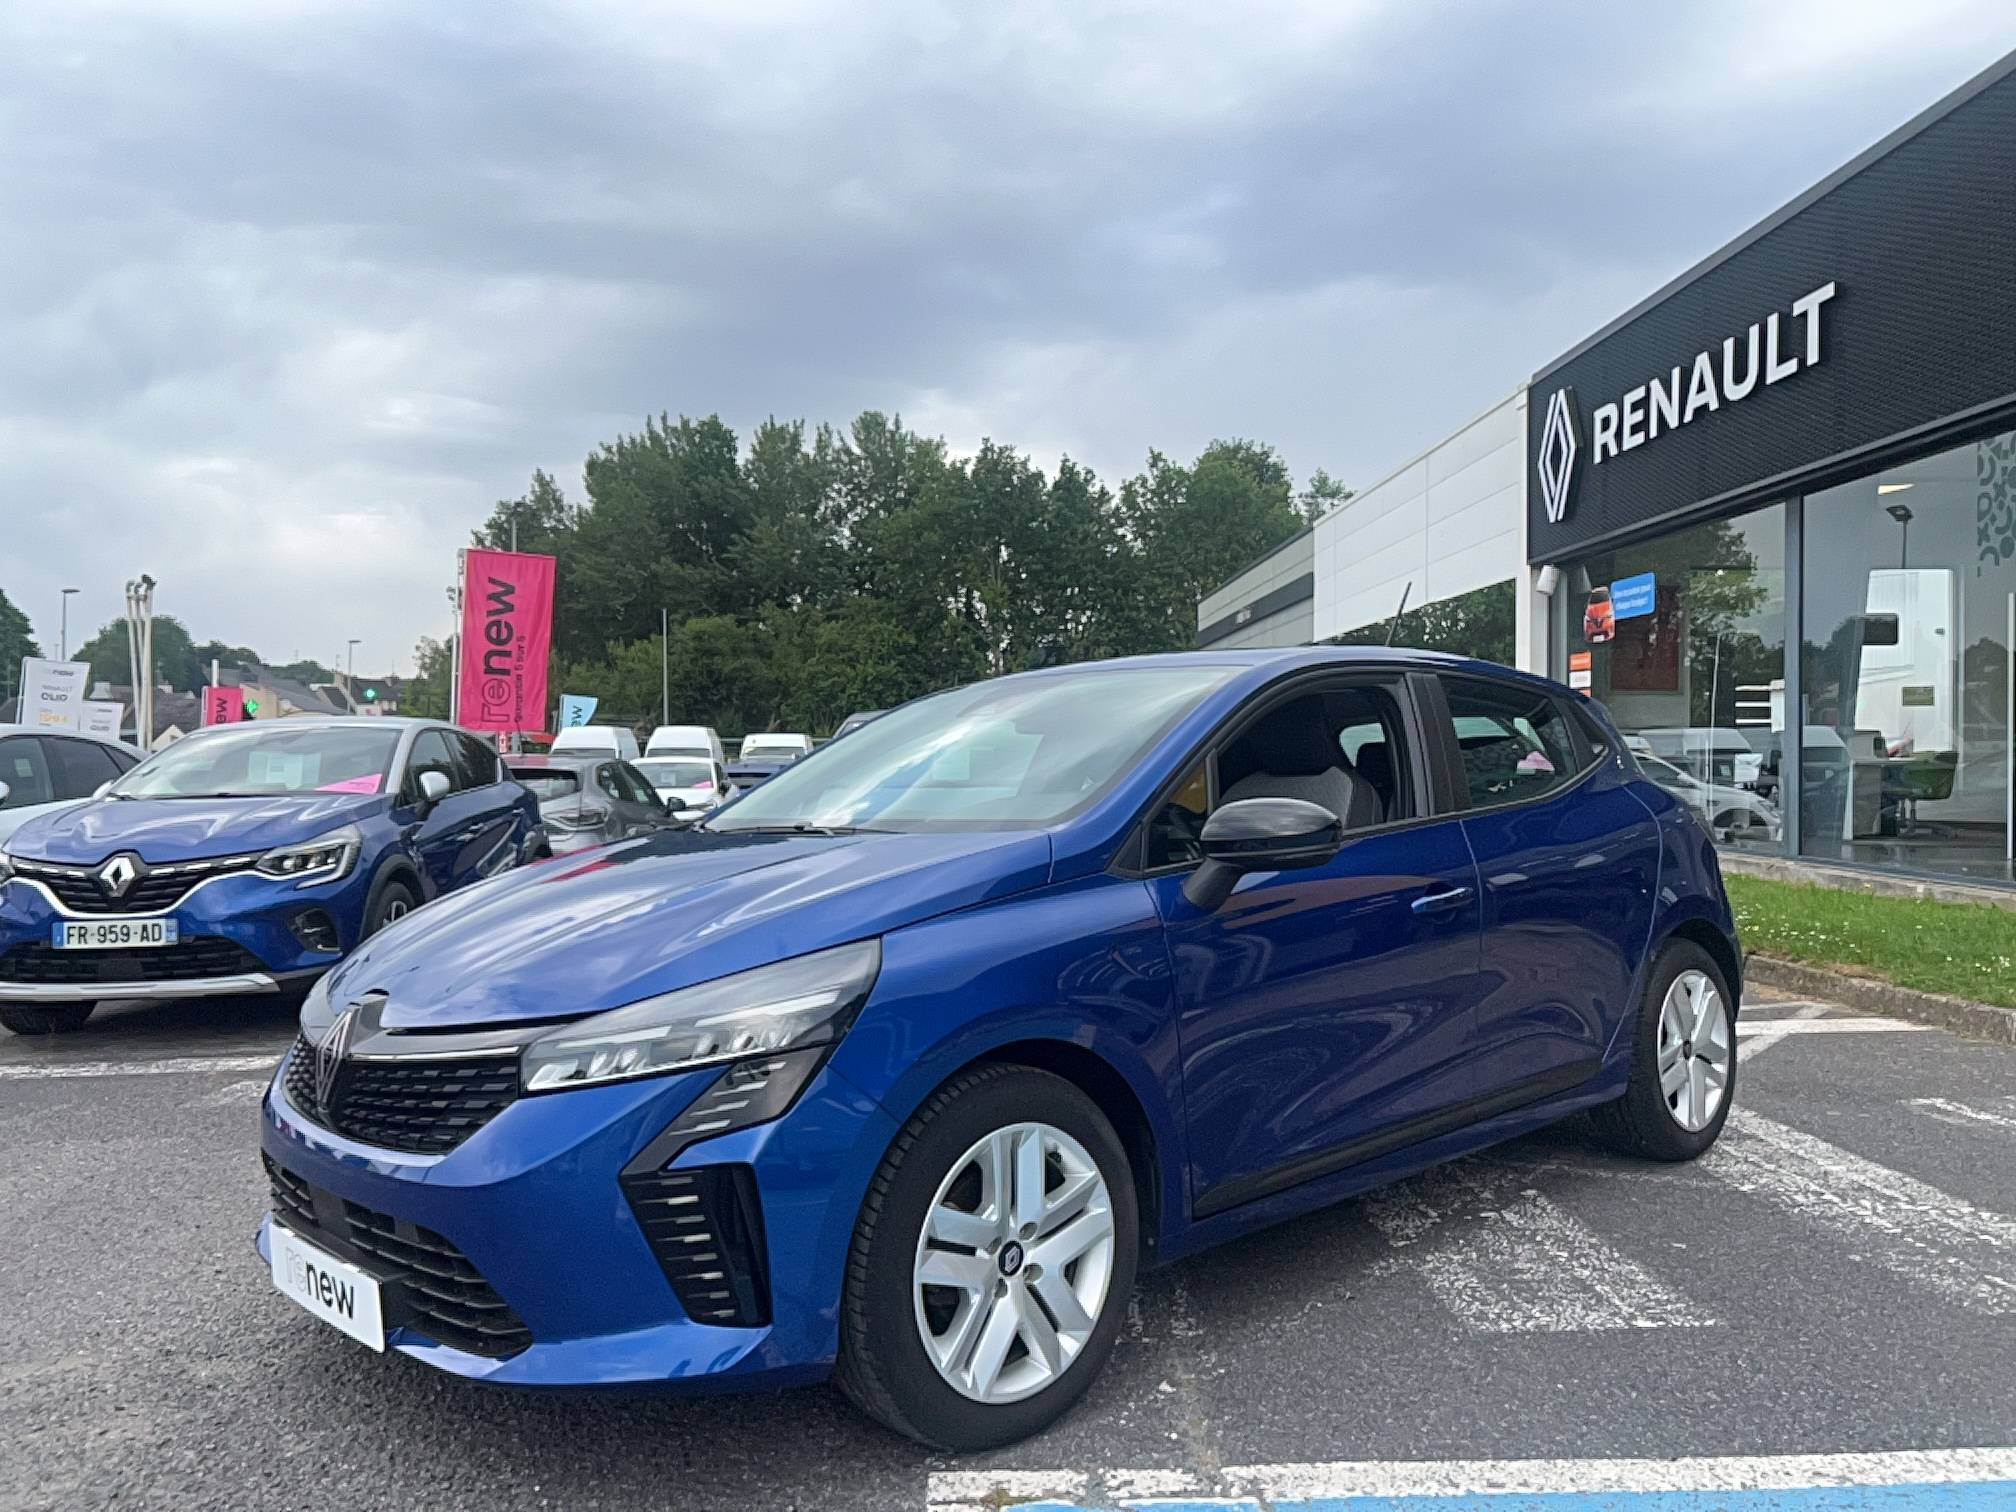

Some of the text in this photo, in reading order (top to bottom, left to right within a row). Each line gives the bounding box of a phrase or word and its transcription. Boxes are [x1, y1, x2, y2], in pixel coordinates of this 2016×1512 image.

[1593, 281, 1836, 465] RENAULT
[481, 576, 516, 723] renew
[66, 923, 162, 945] FR-959-AD
